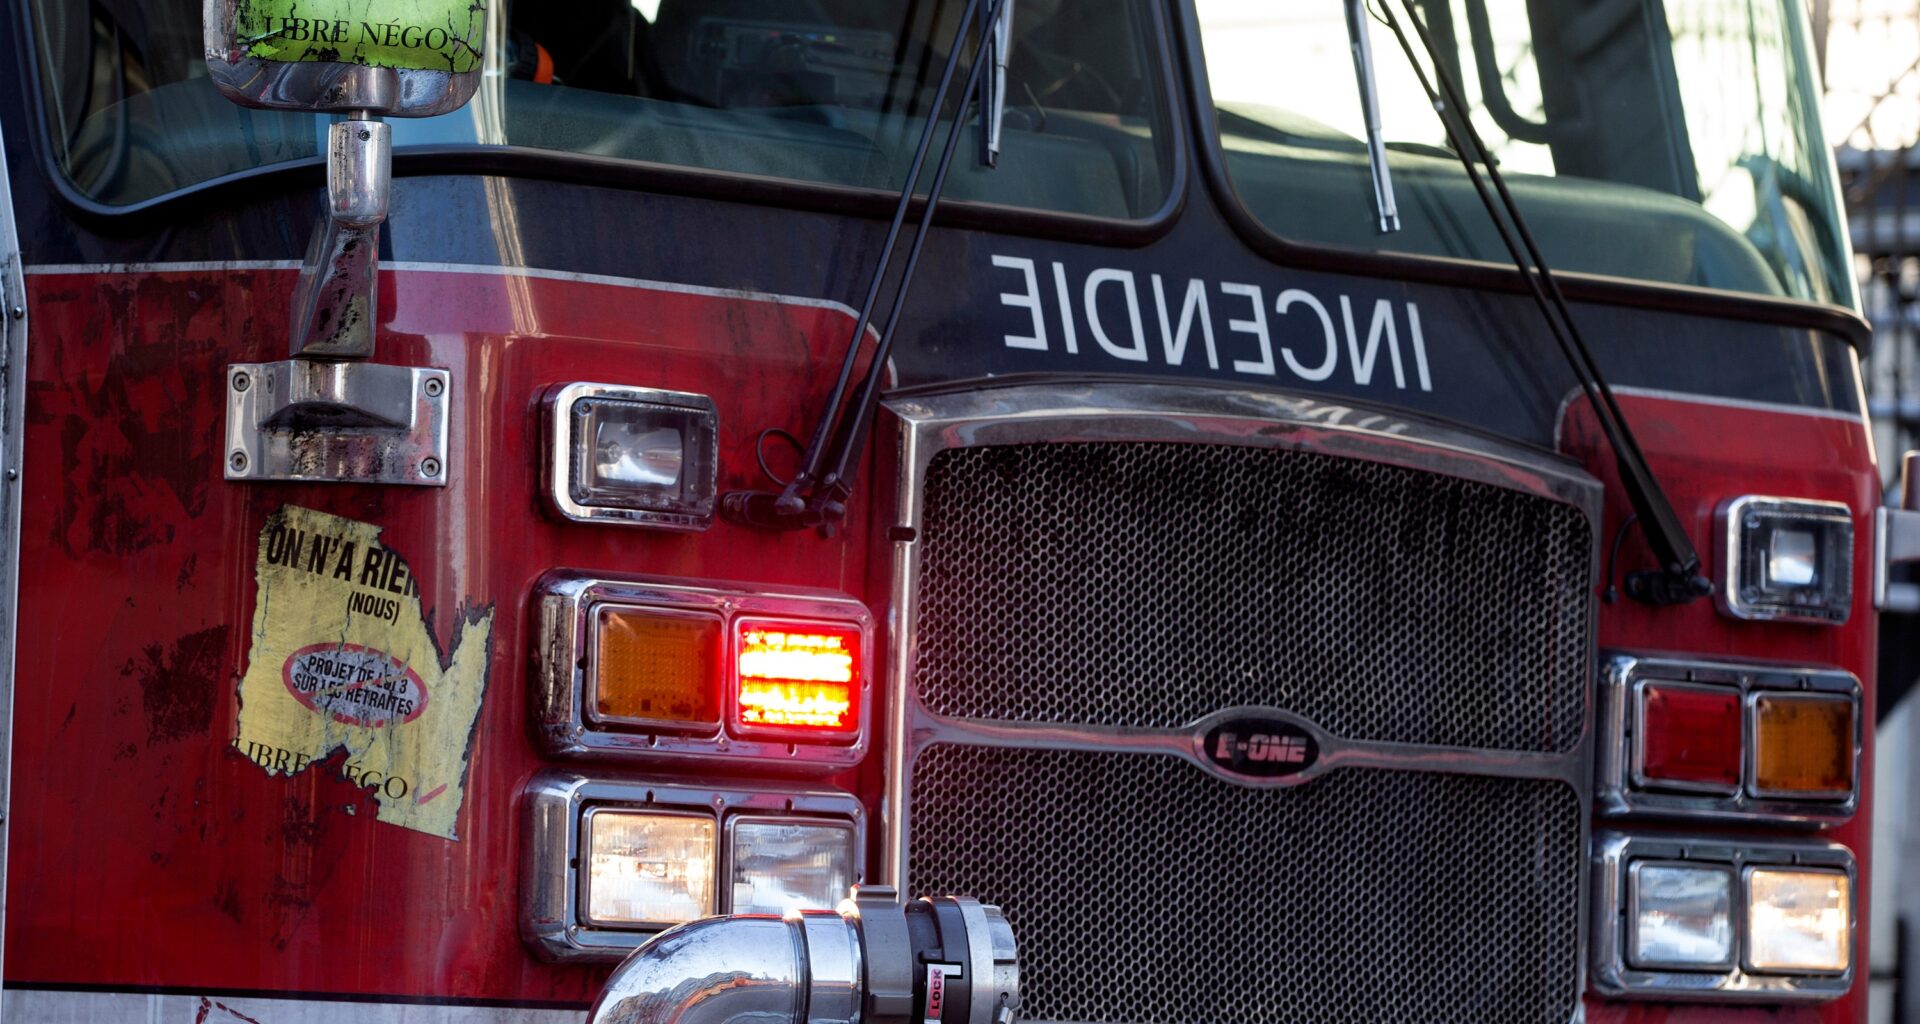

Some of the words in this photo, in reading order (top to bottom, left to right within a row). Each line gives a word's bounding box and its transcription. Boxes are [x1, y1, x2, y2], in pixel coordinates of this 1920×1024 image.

[360, 17, 449, 50] NÉGO
[266, 524, 305, 568] ON
[307, 533, 354, 581] N'A
[348, 591, 400, 626] (NOUS)
[308, 656, 355, 681] PROJET
[293, 673, 319, 692] SUR
[345, 689, 413, 716] RETRAITES
[1215, 732, 1307, 763] E-ONE
[344, 760, 408, 799] ÉGO
[931, 968, 942, 1010] LOCK
